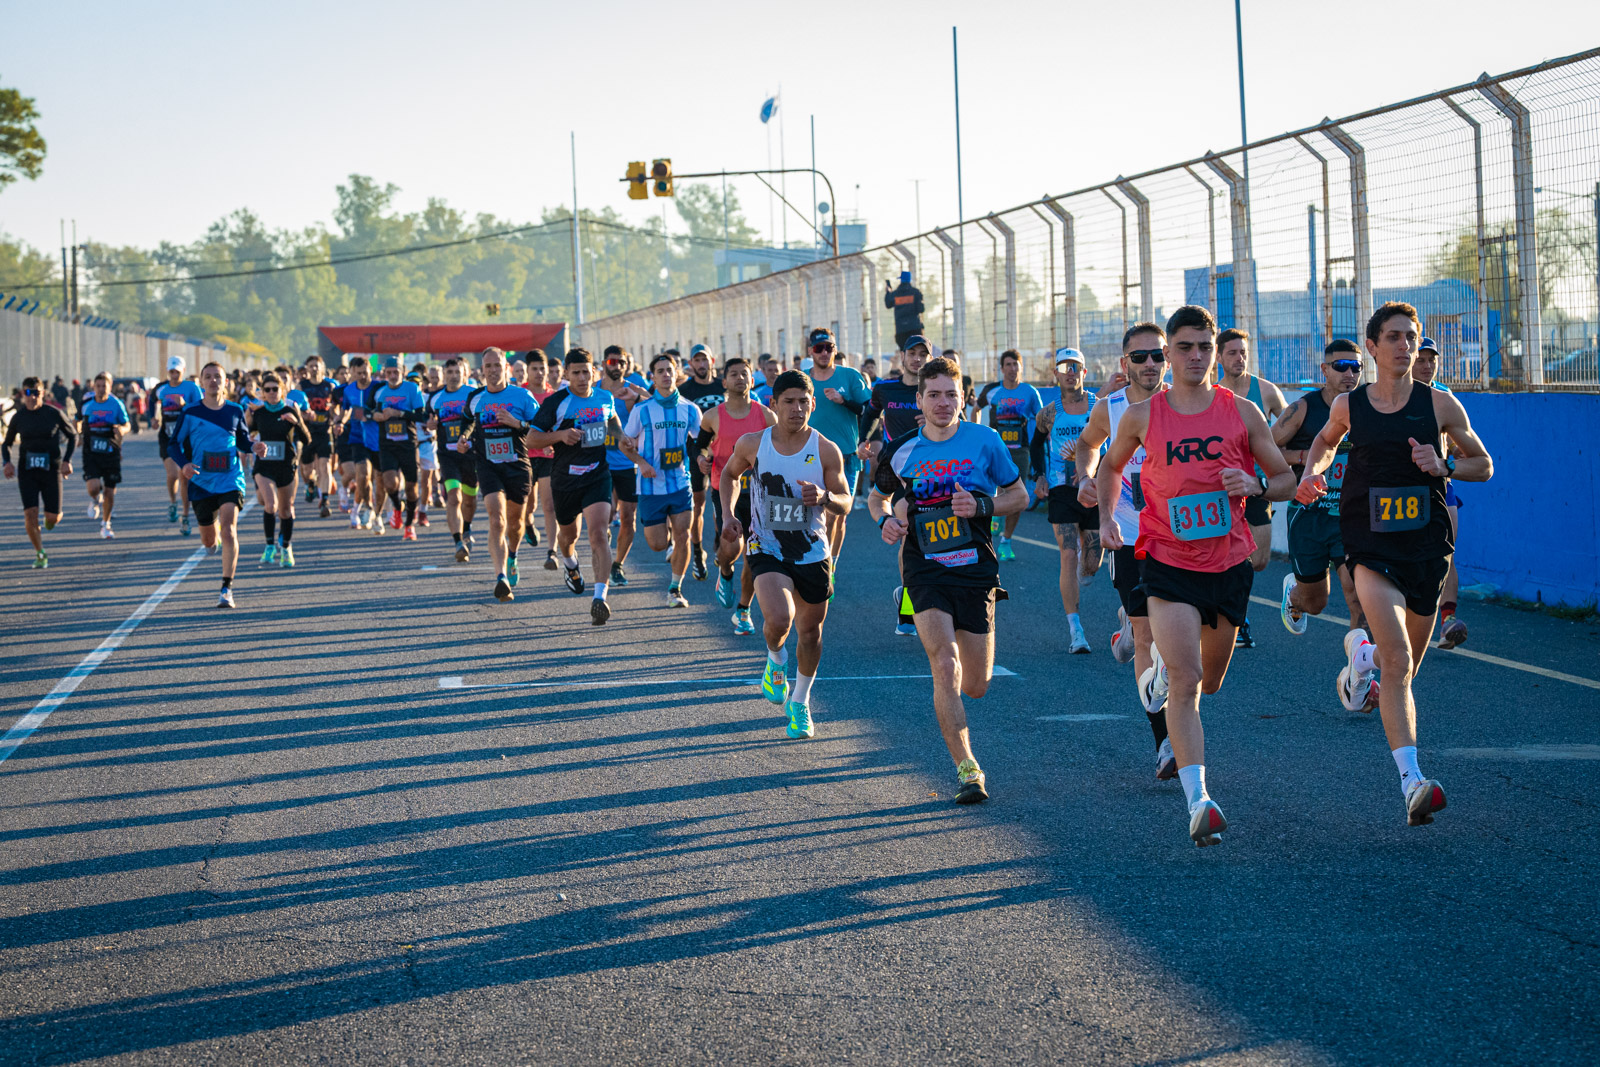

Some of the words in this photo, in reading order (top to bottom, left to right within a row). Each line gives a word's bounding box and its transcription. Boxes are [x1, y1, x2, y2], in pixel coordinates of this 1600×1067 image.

[586, 427, 604, 441] 105
[1002, 431, 1019, 441] 688
[489, 442, 510, 455] 359
[665, 450, 682, 464] 705
[1166, 436, 1224, 466] KRC
[30, 457, 45, 468] 167
[773, 503, 804, 523] 174
[1179, 502, 1220, 530] 313
[1380, 496, 1419, 520] 718
[924, 516, 961, 543] 707
